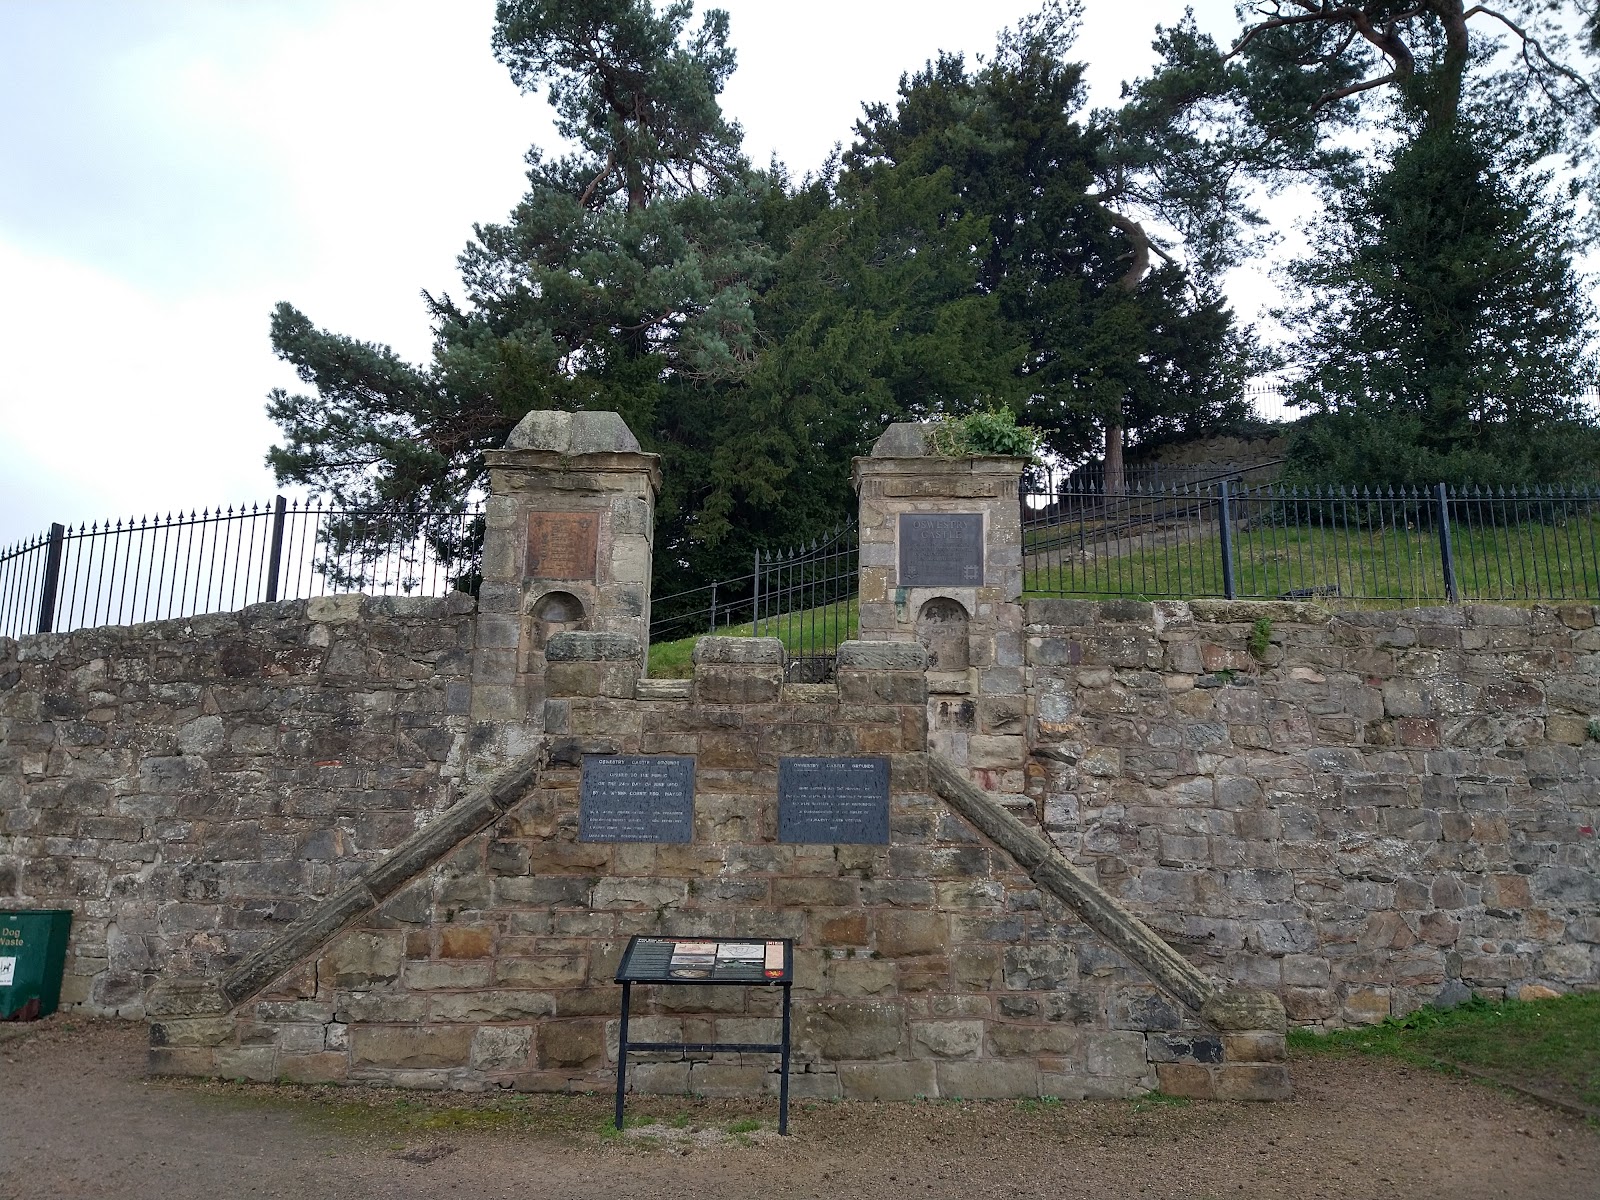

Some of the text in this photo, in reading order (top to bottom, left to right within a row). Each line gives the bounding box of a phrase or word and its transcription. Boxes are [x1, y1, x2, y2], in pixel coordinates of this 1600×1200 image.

[913, 520, 968, 529] OSWESTRY
[921, 530, 962, 539] CASTLE
[2, 927, 21, 938] Dog
[0, 937, 24, 947] Waste
